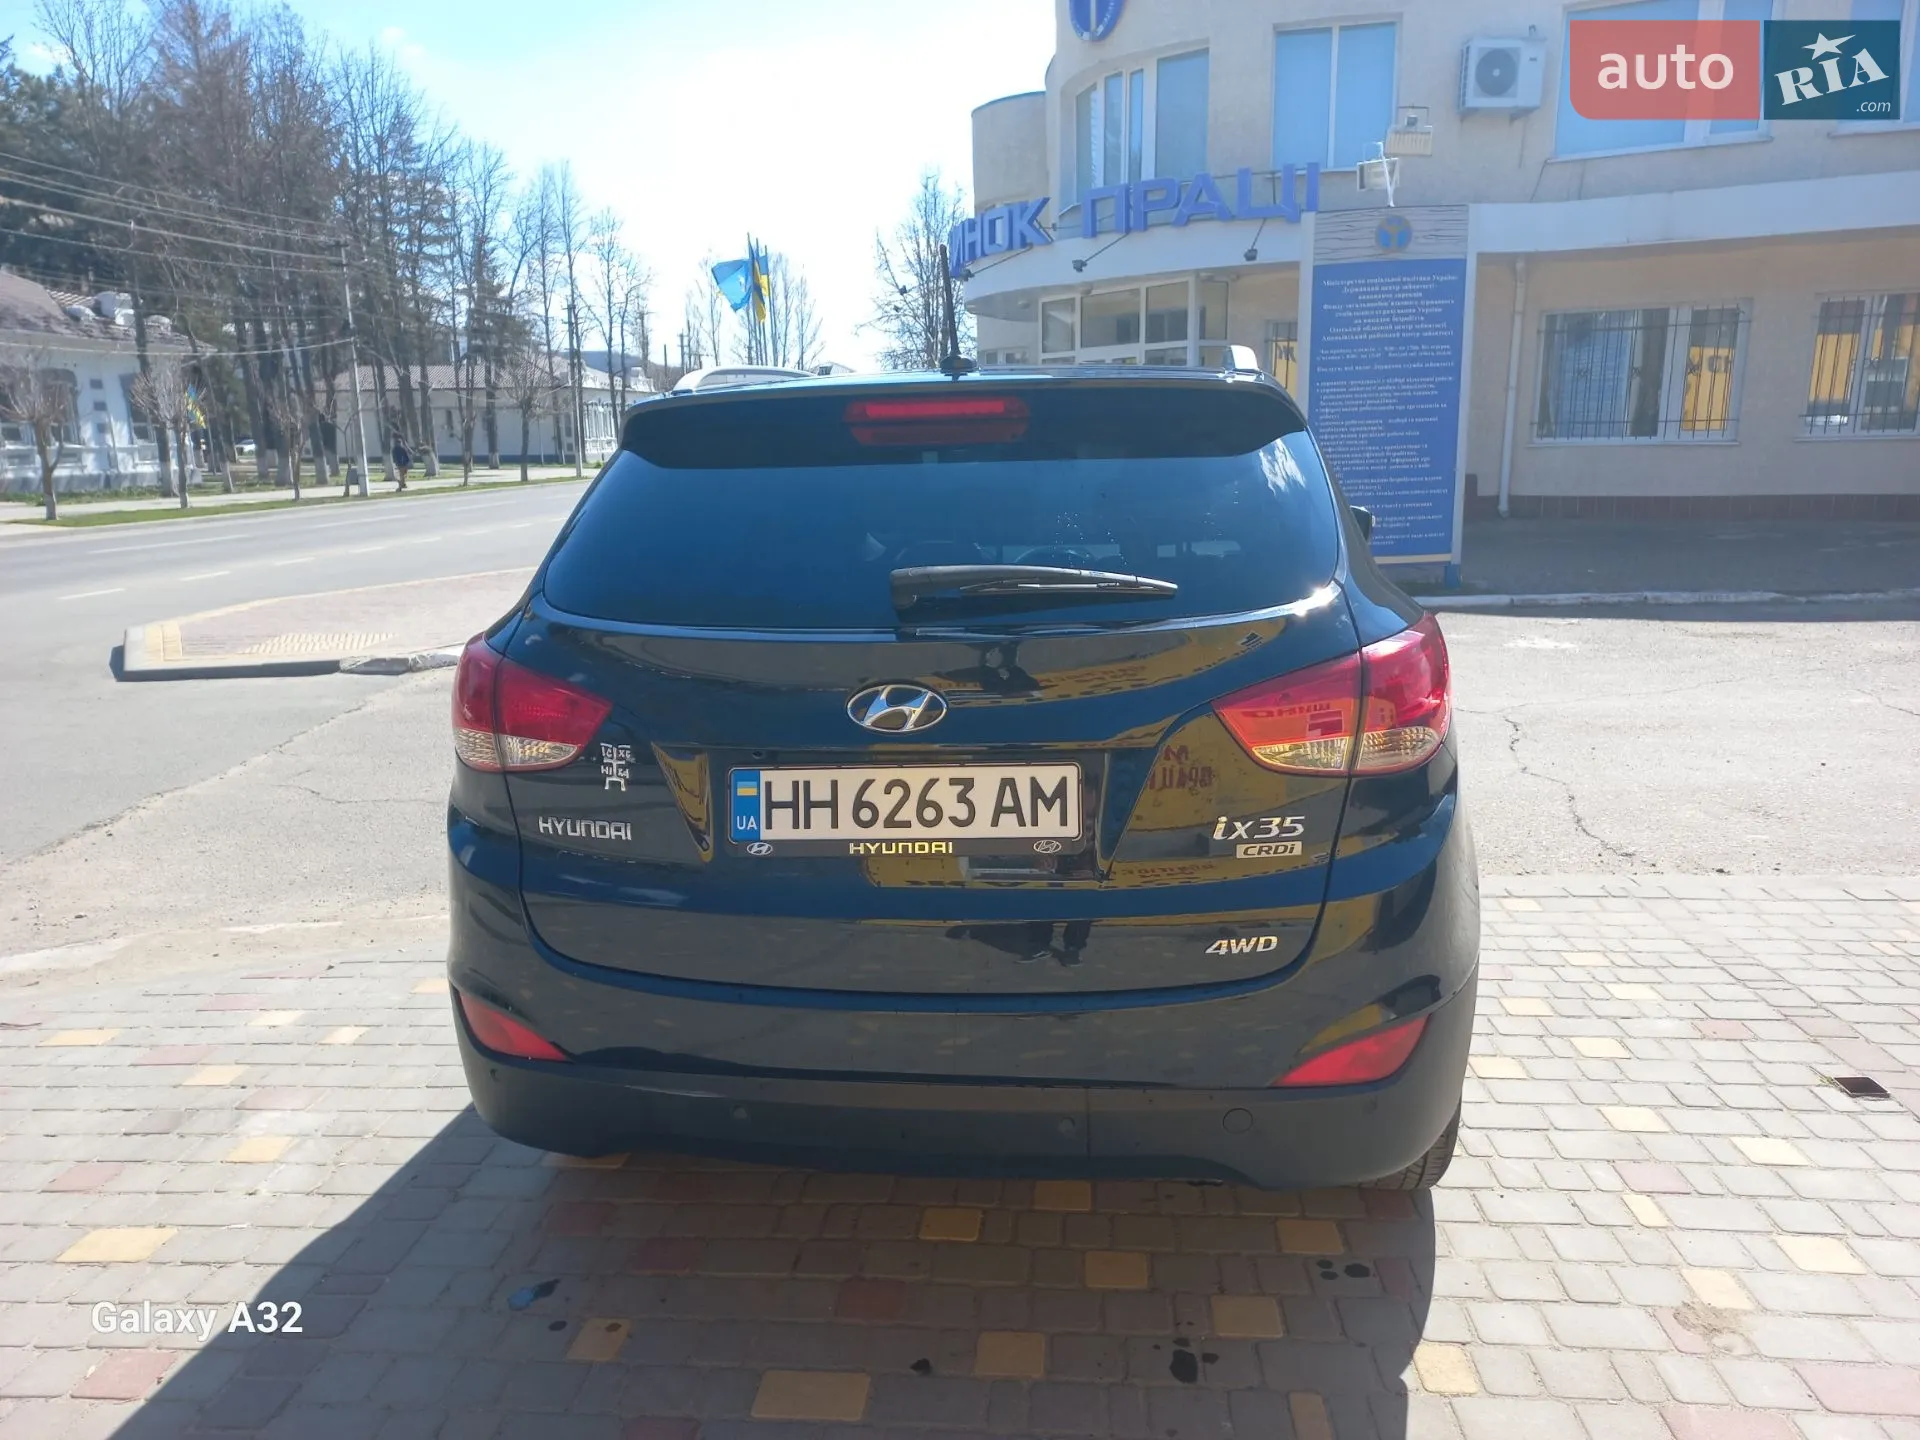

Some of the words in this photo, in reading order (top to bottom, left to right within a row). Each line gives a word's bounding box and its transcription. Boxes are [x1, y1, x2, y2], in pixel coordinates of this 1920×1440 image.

[1083, 162, 1321, 239] ПРАЦІ
[736, 815, 758, 831] UA
[764, 779, 839, 830] HH
[852, 777, 976, 829] 6263
[990, 775, 1068, 828] AM
[538, 815, 633, 841] HYUNDAI
[1212, 815, 1306, 841] ix35
[849, 841, 953, 855] HYUNDAI
[1243, 843, 1297, 857] CRDi
[1205, 935, 1279, 956] 4WD
